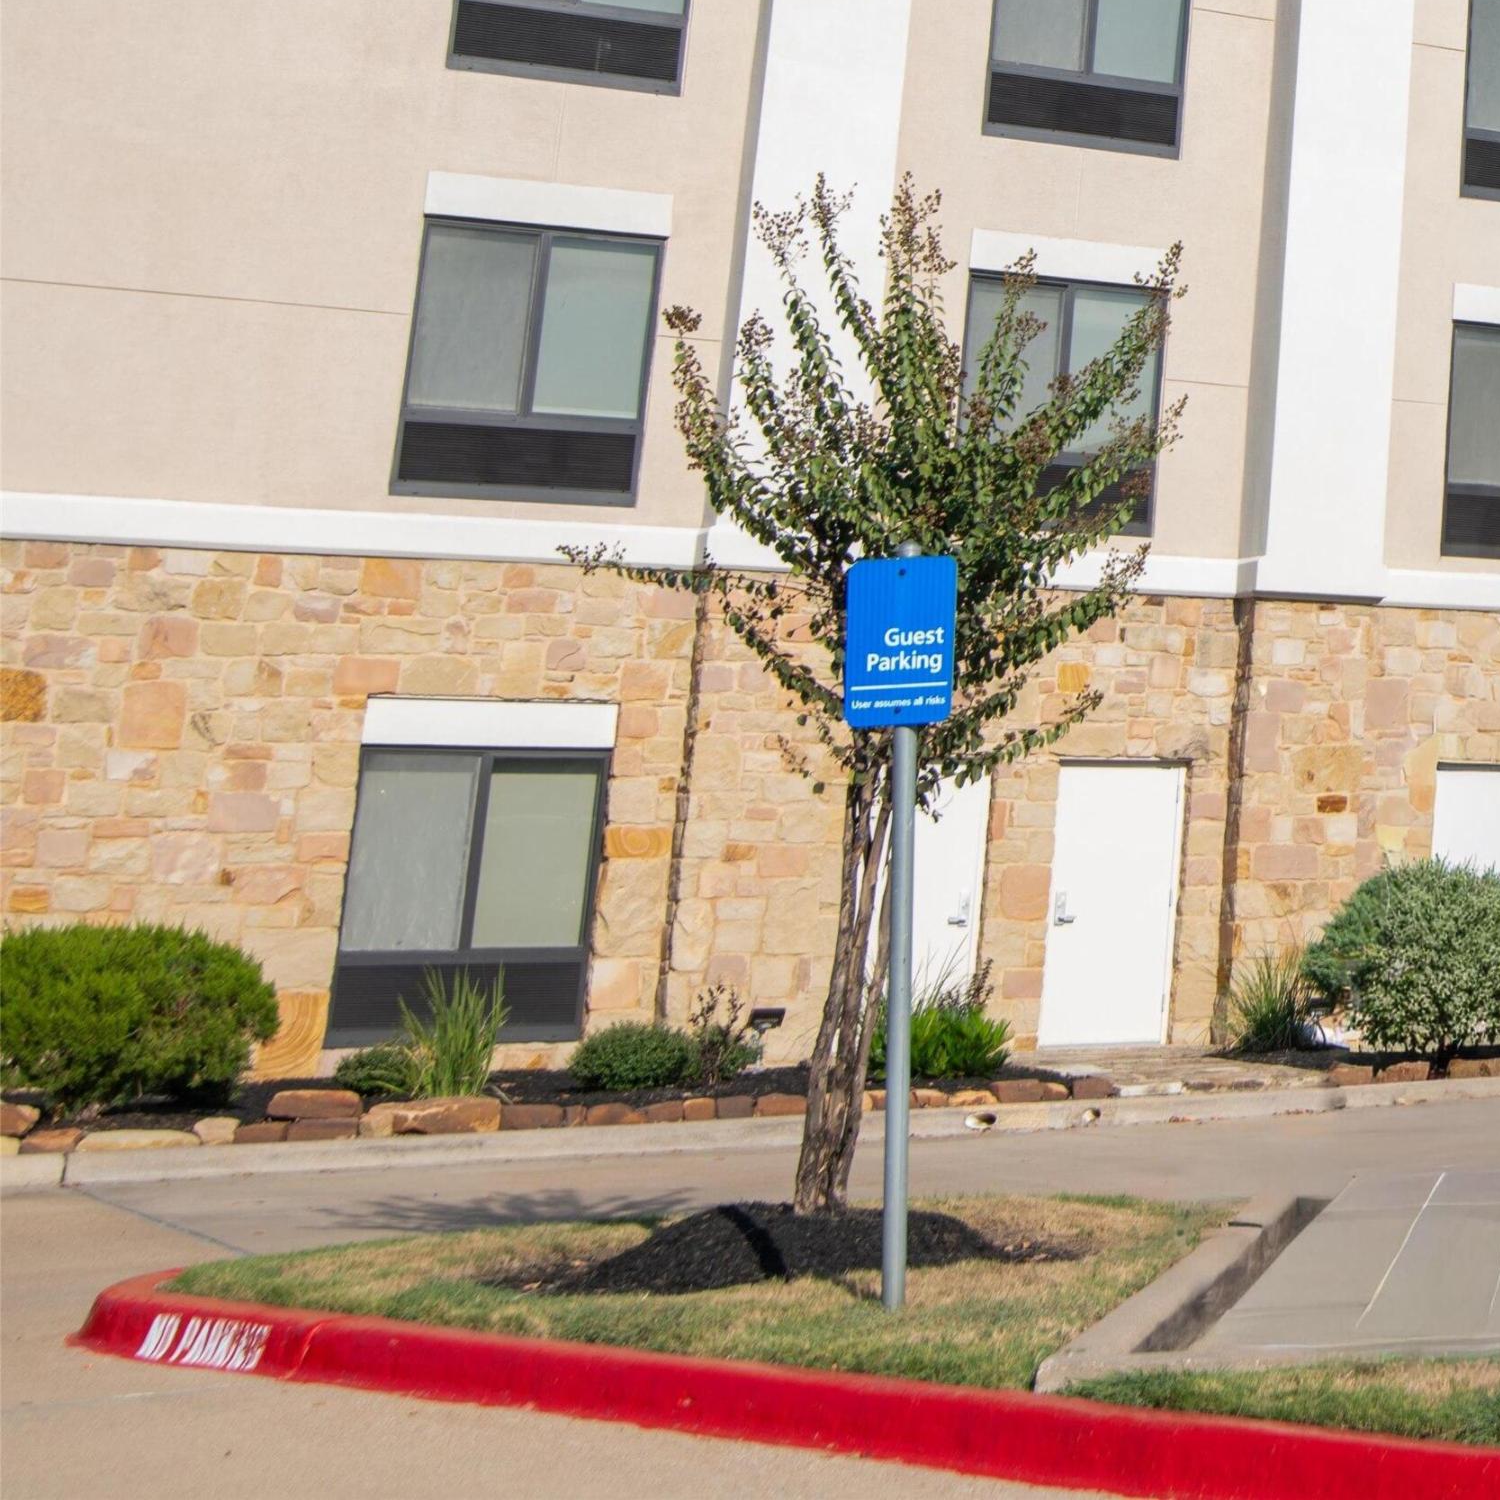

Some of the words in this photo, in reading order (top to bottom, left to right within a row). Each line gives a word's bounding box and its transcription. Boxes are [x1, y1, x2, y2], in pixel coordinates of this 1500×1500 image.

[884, 626, 945, 647] Guest
[866, 650, 943, 674] Parking
[851, 700, 872, 709] User
[873, 698, 911, 708] assumes
[913, 696, 924, 706] all
[925, 696, 946, 704] risks
